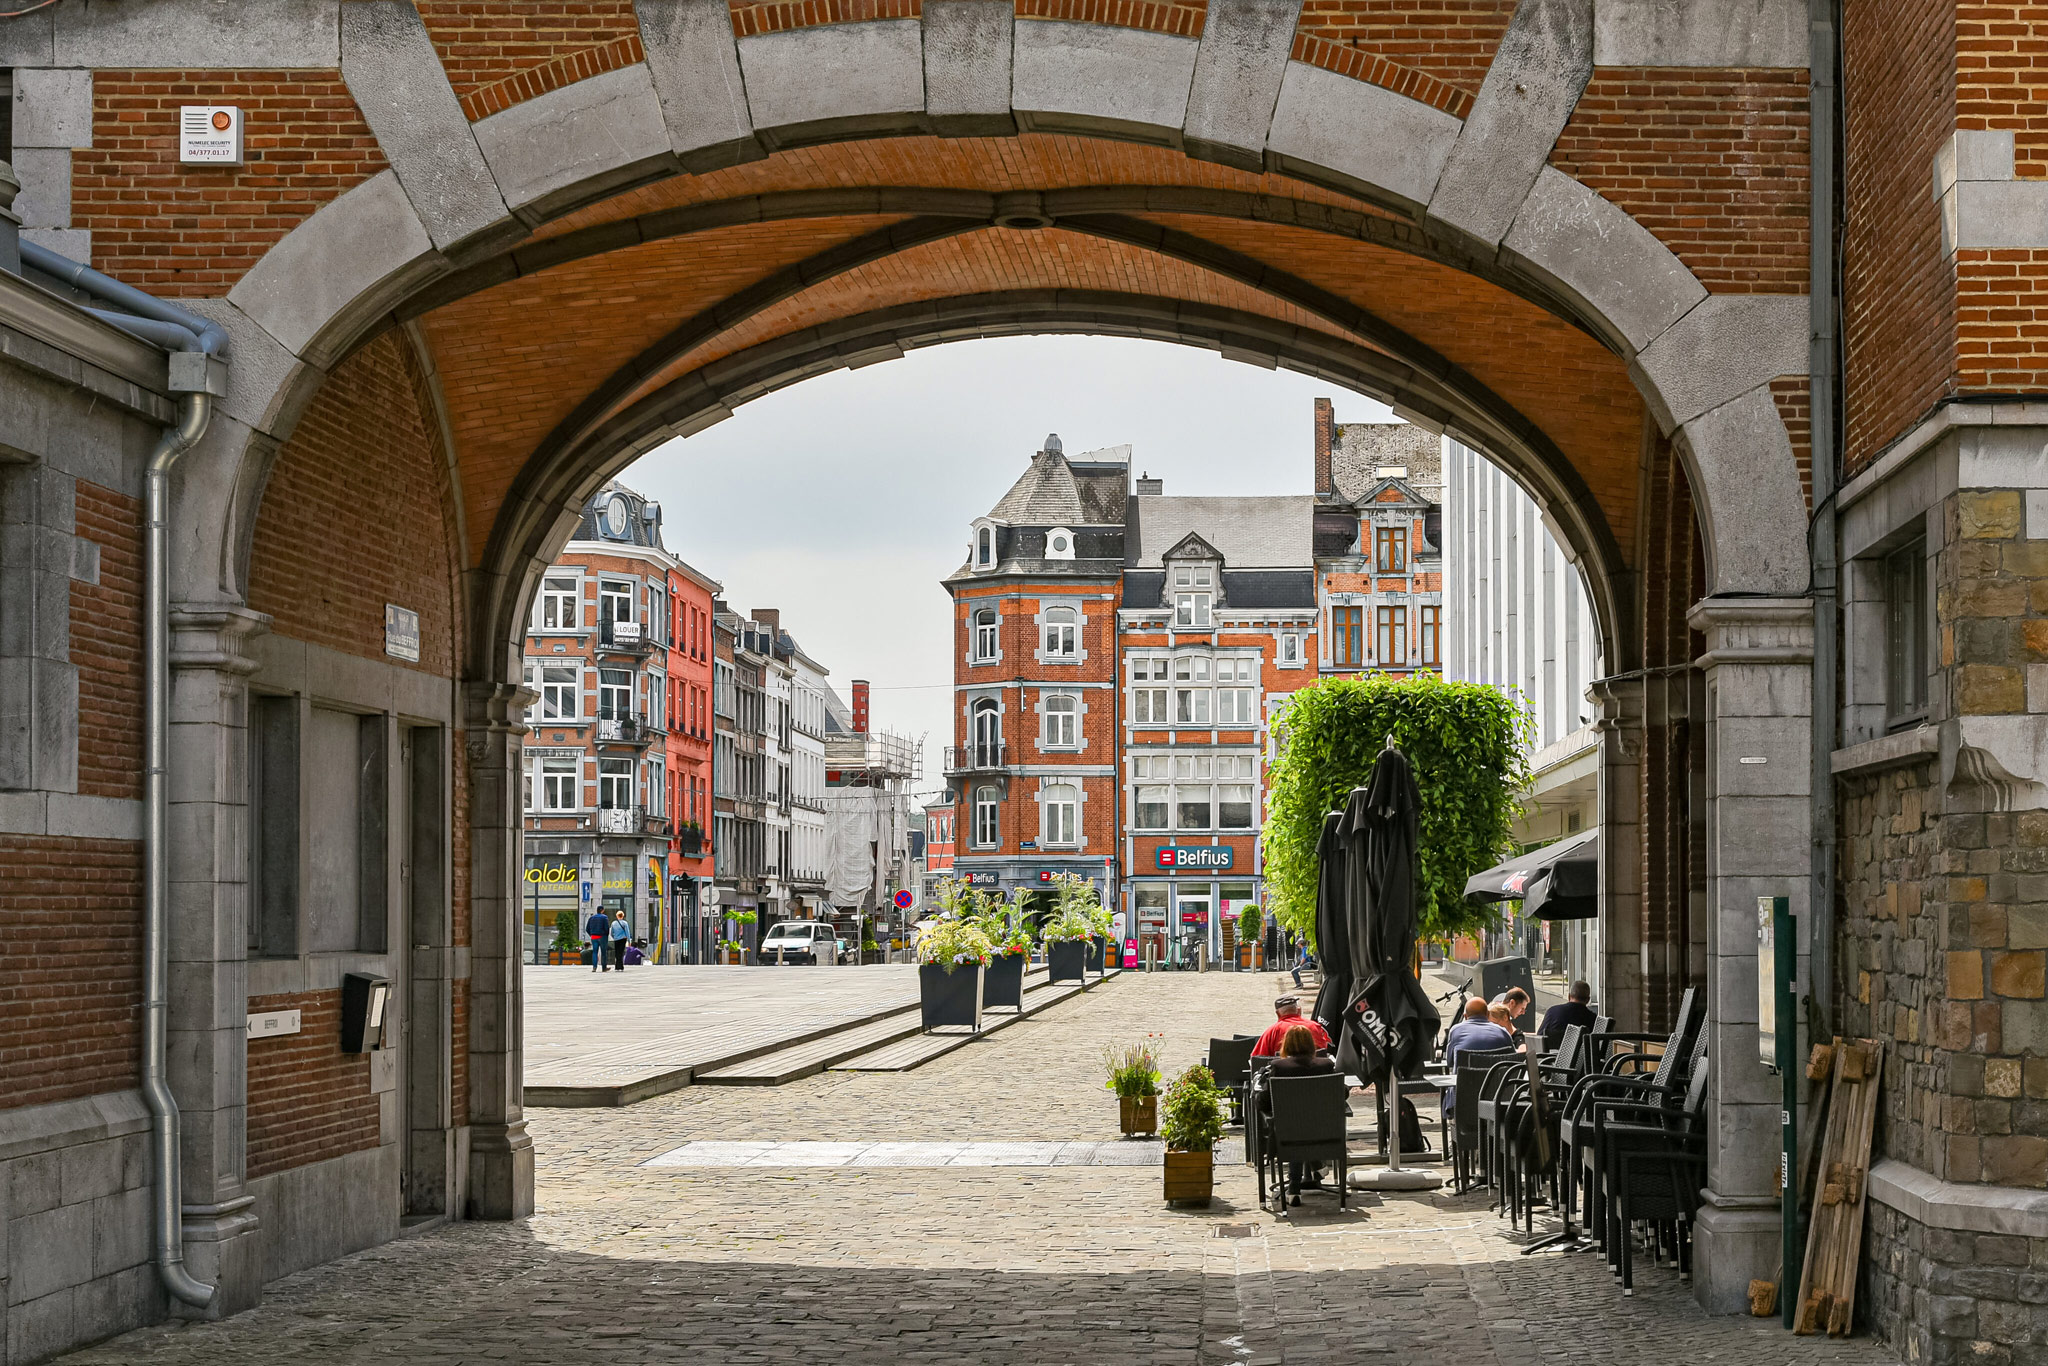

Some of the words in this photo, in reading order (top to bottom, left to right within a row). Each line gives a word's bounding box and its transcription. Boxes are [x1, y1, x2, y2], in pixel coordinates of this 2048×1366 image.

[620, 626, 639, 634] LOUER
[1177, 849, 1229, 865] Belfius
[972, 873, 995, 883] Belfius
[538, 883, 575, 892] INTERIM
